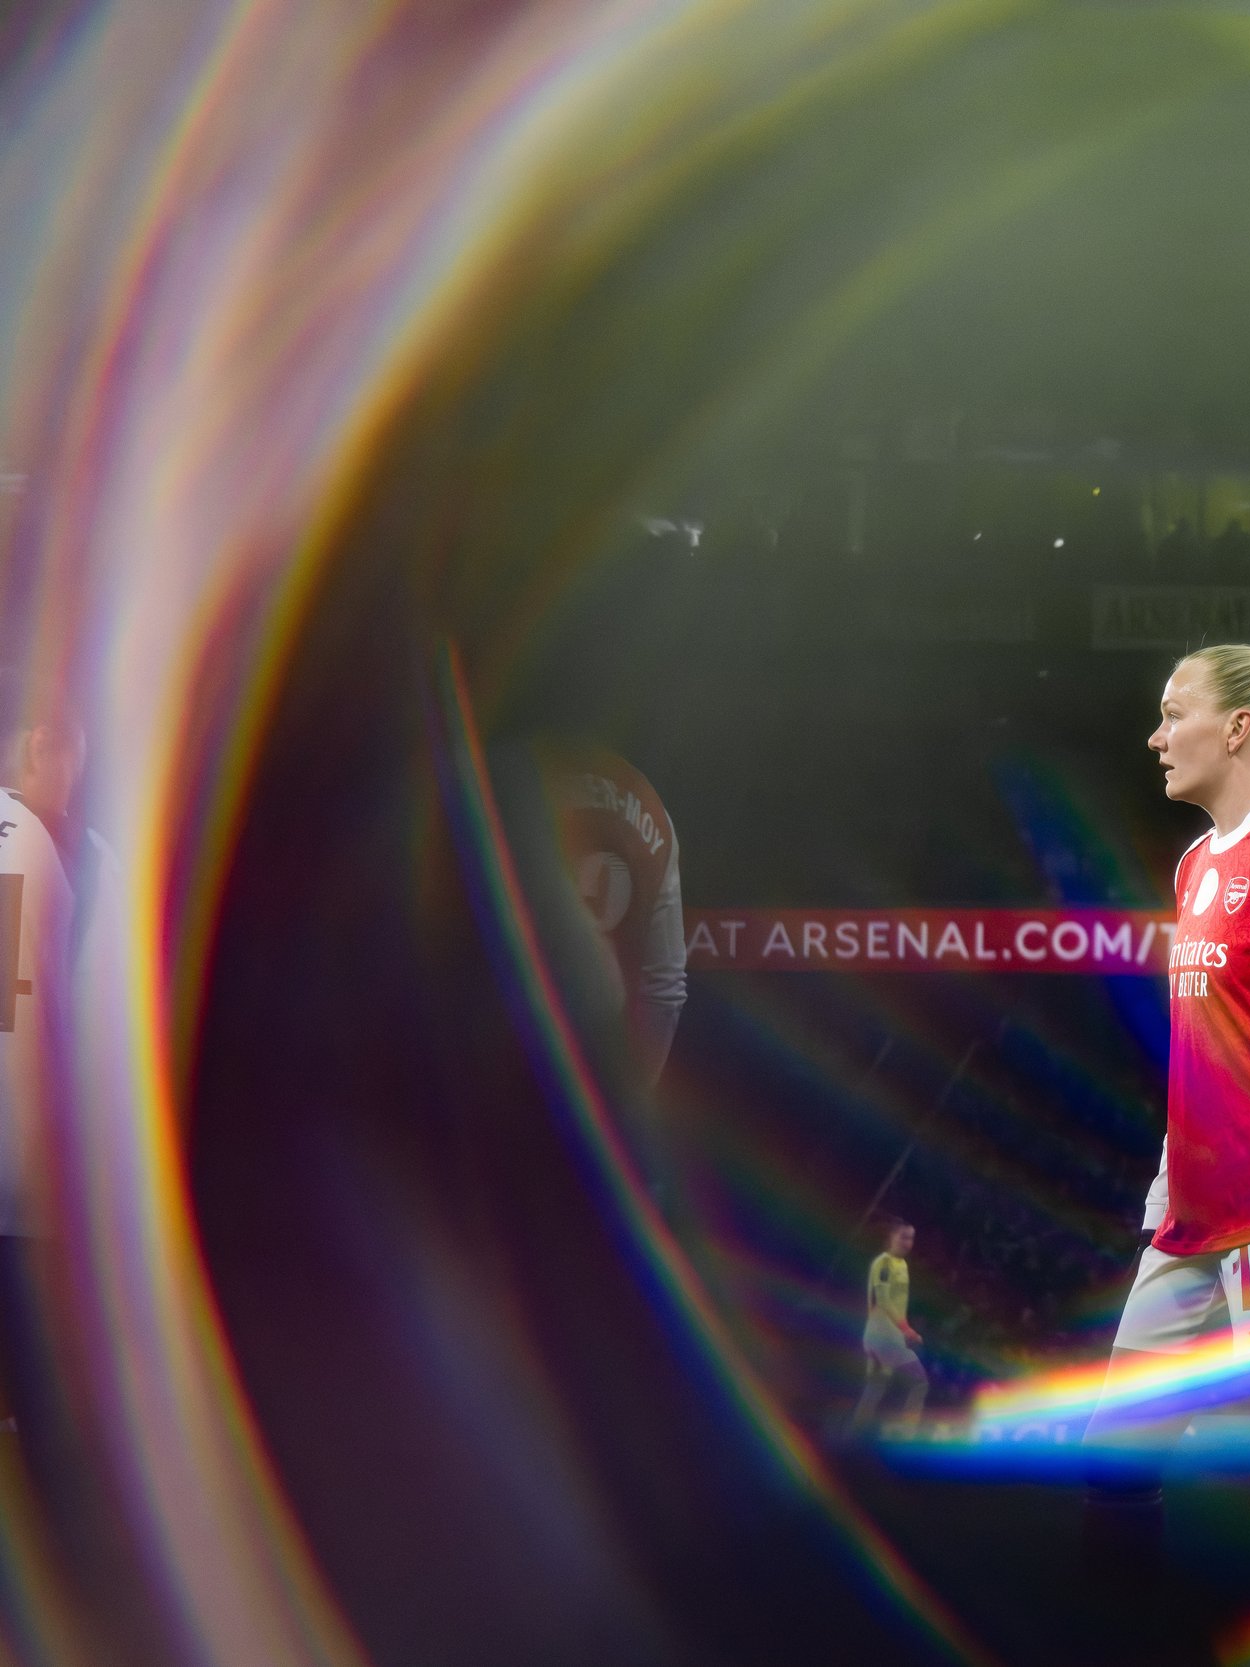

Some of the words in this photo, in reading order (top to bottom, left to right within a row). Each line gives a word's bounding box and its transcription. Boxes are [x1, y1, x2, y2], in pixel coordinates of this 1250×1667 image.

[687, 922, 746, 957] AT
[762, 921, 1177, 964] ARSENAL.COM/T
[1169, 935, 1228, 968] mirates
